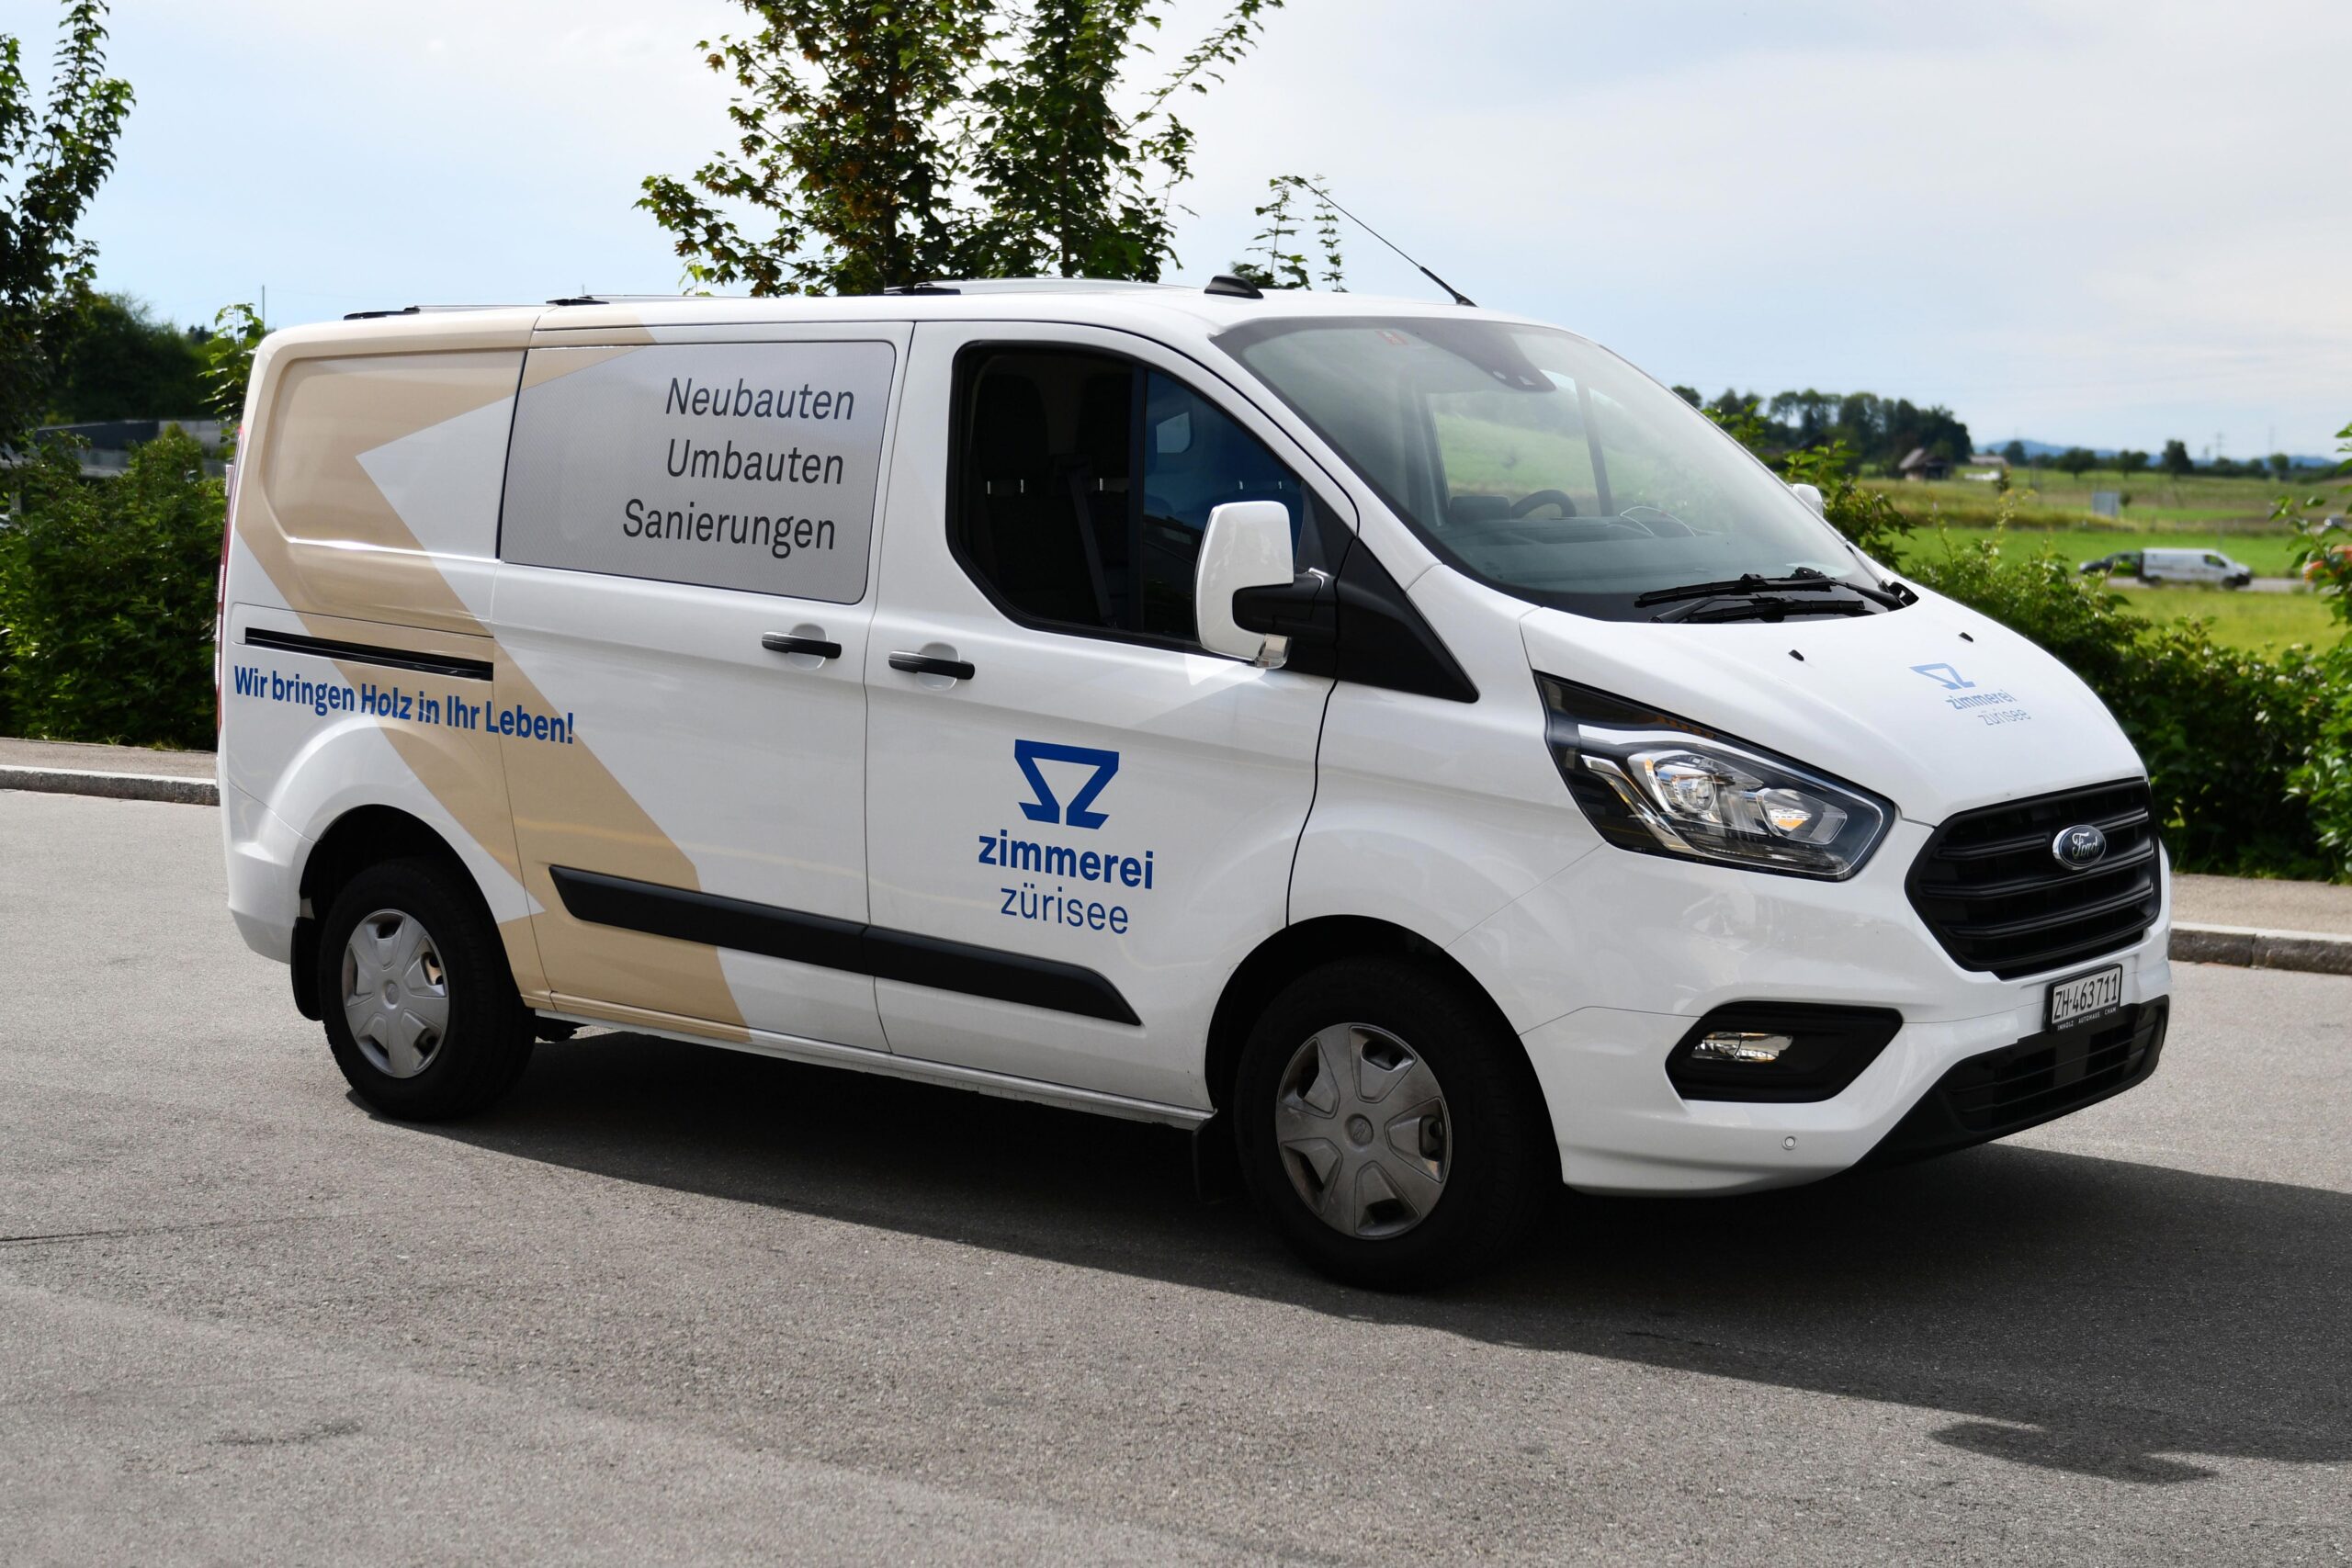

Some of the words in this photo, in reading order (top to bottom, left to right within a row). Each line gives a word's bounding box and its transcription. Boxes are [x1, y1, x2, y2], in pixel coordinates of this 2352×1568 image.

[665, 378, 854, 420] Neubauten
[667, 439, 843, 484] Umbauten
[623, 499, 835, 558] Sanierungen
[234, 665, 268, 698] Wir
[272, 671, 355, 716] bringen
[361, 683, 412, 720] Holz
[418, 691, 439, 724] in
[447, 695, 481, 729] Ihr
[486, 701, 573, 744] Leben!
[1946, 689, 2017, 709] zimmerei
[1978, 708, 2031, 726] zürisee
[978, 829, 1154, 890] zimmerei
[2072, 831, 2099, 860] Ford
[1000, 882, 1129, 935] zürisee
[2078, 1010, 2100, 1024] AUTOHAUS
